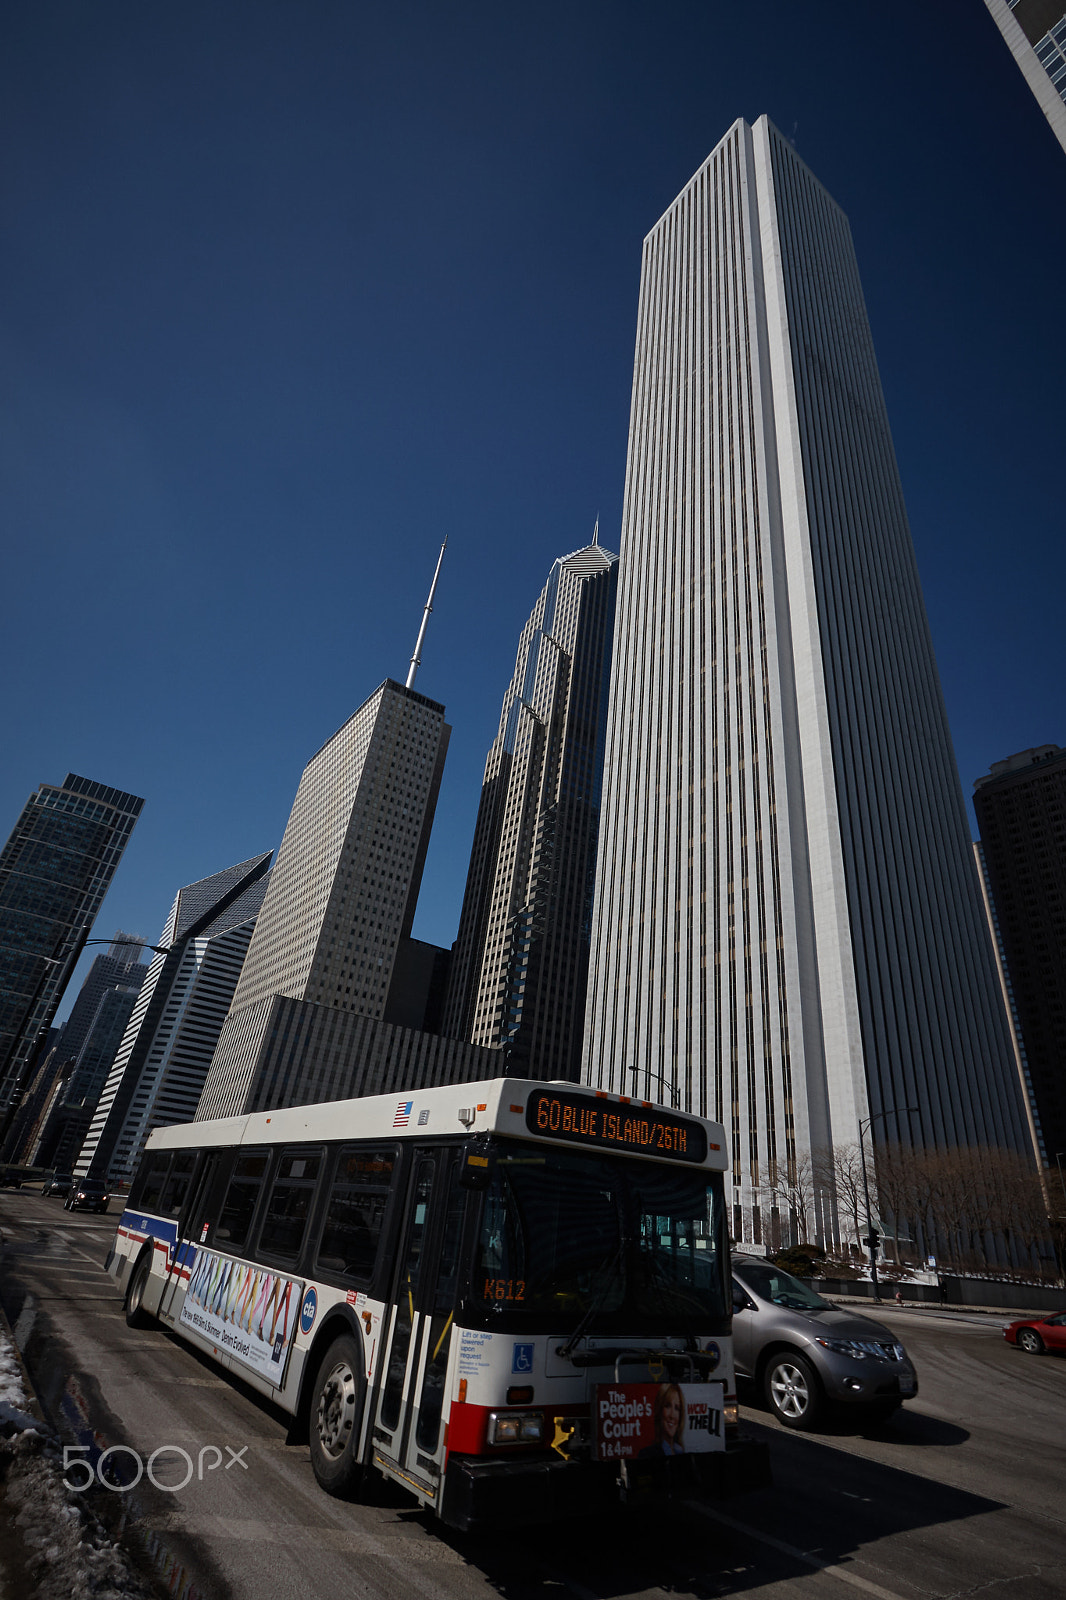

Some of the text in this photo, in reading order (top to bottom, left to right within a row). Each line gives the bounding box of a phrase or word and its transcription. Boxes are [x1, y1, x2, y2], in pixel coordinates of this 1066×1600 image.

[537, 1097, 687, 1152] 60 BLUE ISLAND/26TH
[748, 1245, 766, 1254] Center
[483, 1278, 526, 1301] K612
[303, 1301, 315, 1318] cta
[221, 1329, 234, 1347] Denim
[233, 1336, 250, 1356] Evolved
[461, 1338, 484, 1346] lowered
[460, 1352, 482, 1360] request
[608, 1391, 626, 1403] The
[599, 1396, 653, 1422] People's
[603, 1419, 641, 1439] Court
[689, 1415, 709, 1430] THE
